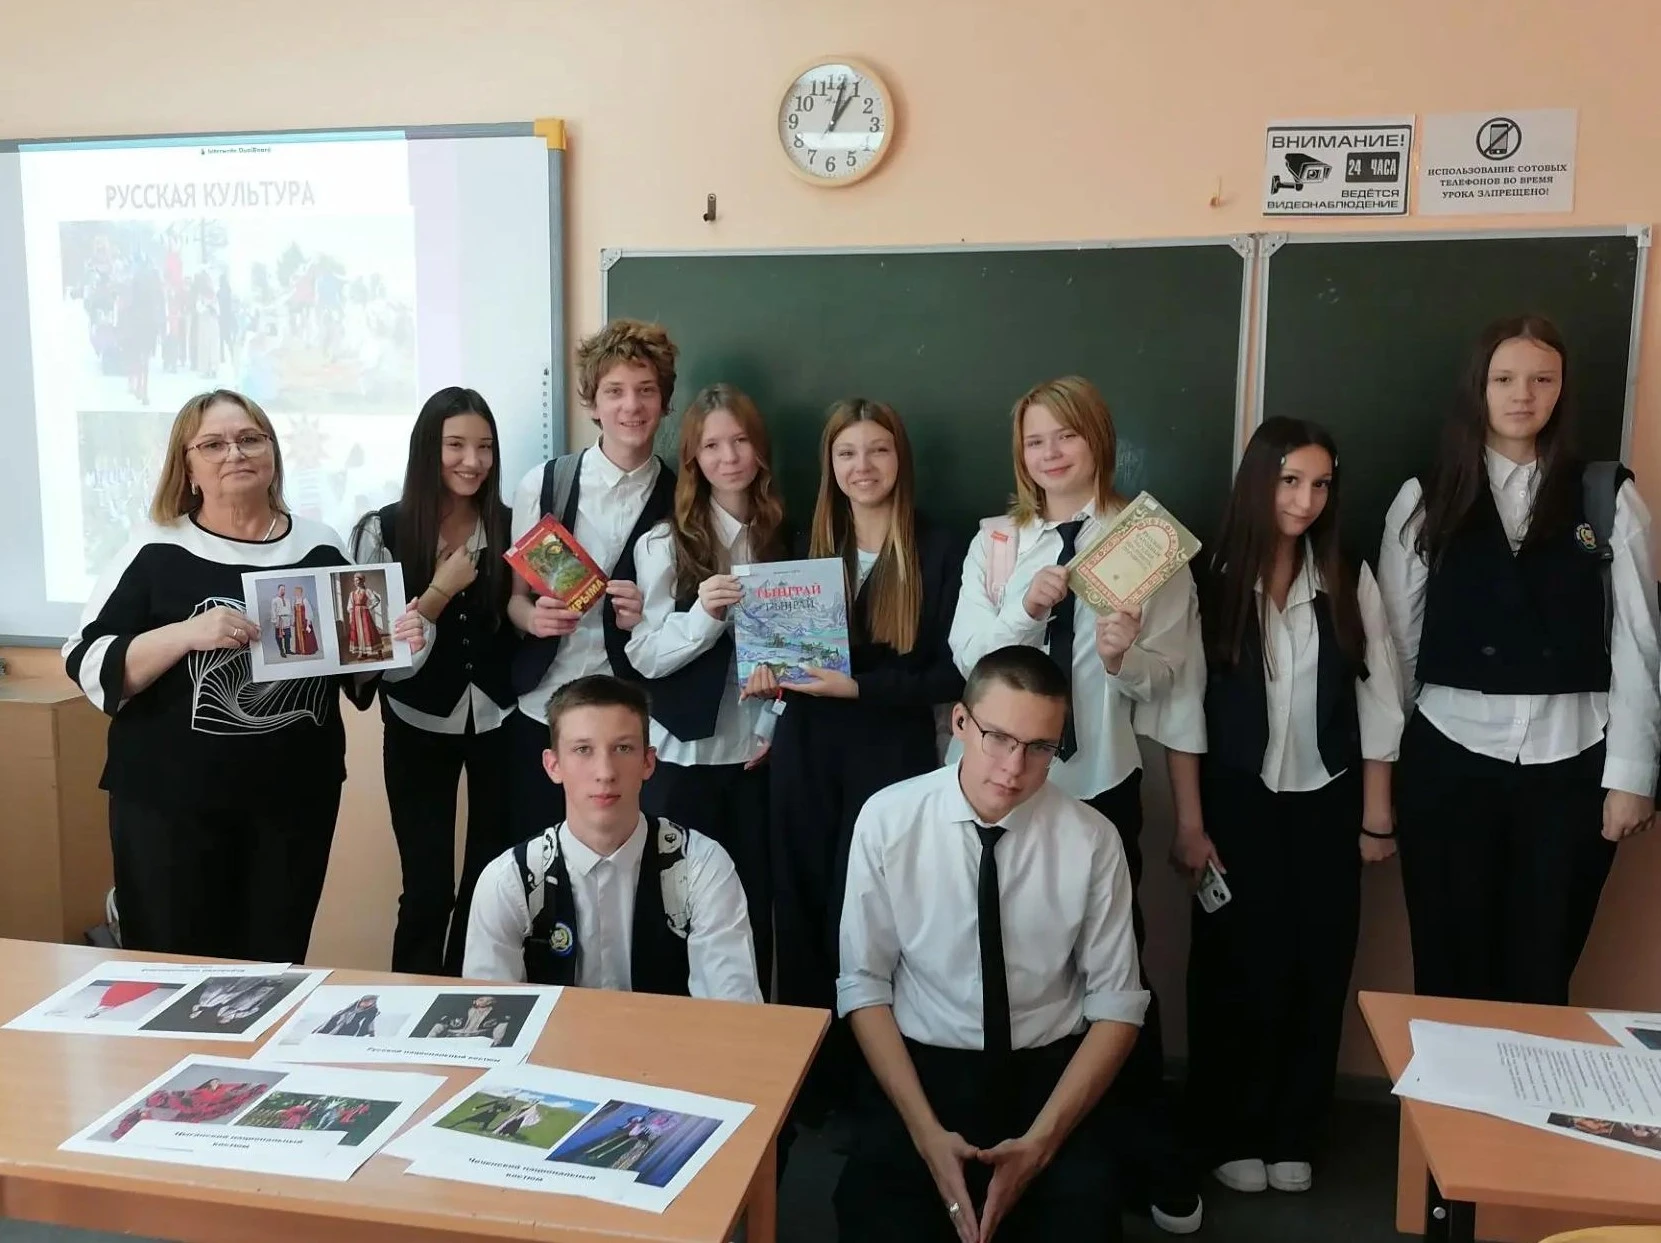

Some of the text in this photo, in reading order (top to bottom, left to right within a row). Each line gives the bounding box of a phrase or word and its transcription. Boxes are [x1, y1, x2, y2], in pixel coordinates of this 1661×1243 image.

[810, 80, 828, 96] 11
[827, 74, 848, 91] 12
[852, 82, 861, 98] 1
[795, 96, 814, 112] 10
[862, 98, 874, 114] 2
[788, 114, 799, 129] 9
[869, 117, 881, 133] 3
[793, 134, 805, 148] 8
[1272, 134, 1405, 149] ВНИМАНИЕ!
[808, 149, 818, 165] 7
[825, 156, 836, 172] 6
[846, 150, 857, 167] 5
[1348, 158, 1397, 176] 24 ЧАСА
[1428, 164, 1567, 176] ИСПОЛЬЗОВАНИЕ СОТОВЫХ
[1440, 178, 1500, 187] ТЕЛЕФОНОВ
[1520, 176, 1554, 184] ВРЕМЯ
[105, 180, 316, 210] РУССКАЯ КУЛЬТУРА
[1341, 188, 1400, 199] ВЕДЁТСЯ
[1442, 187, 1549, 199] УРОКА ЗАПРЕЩЕНО!
[1267, 200, 1399, 210] ВИДЕОНАБЛЮДЕНИЕ
